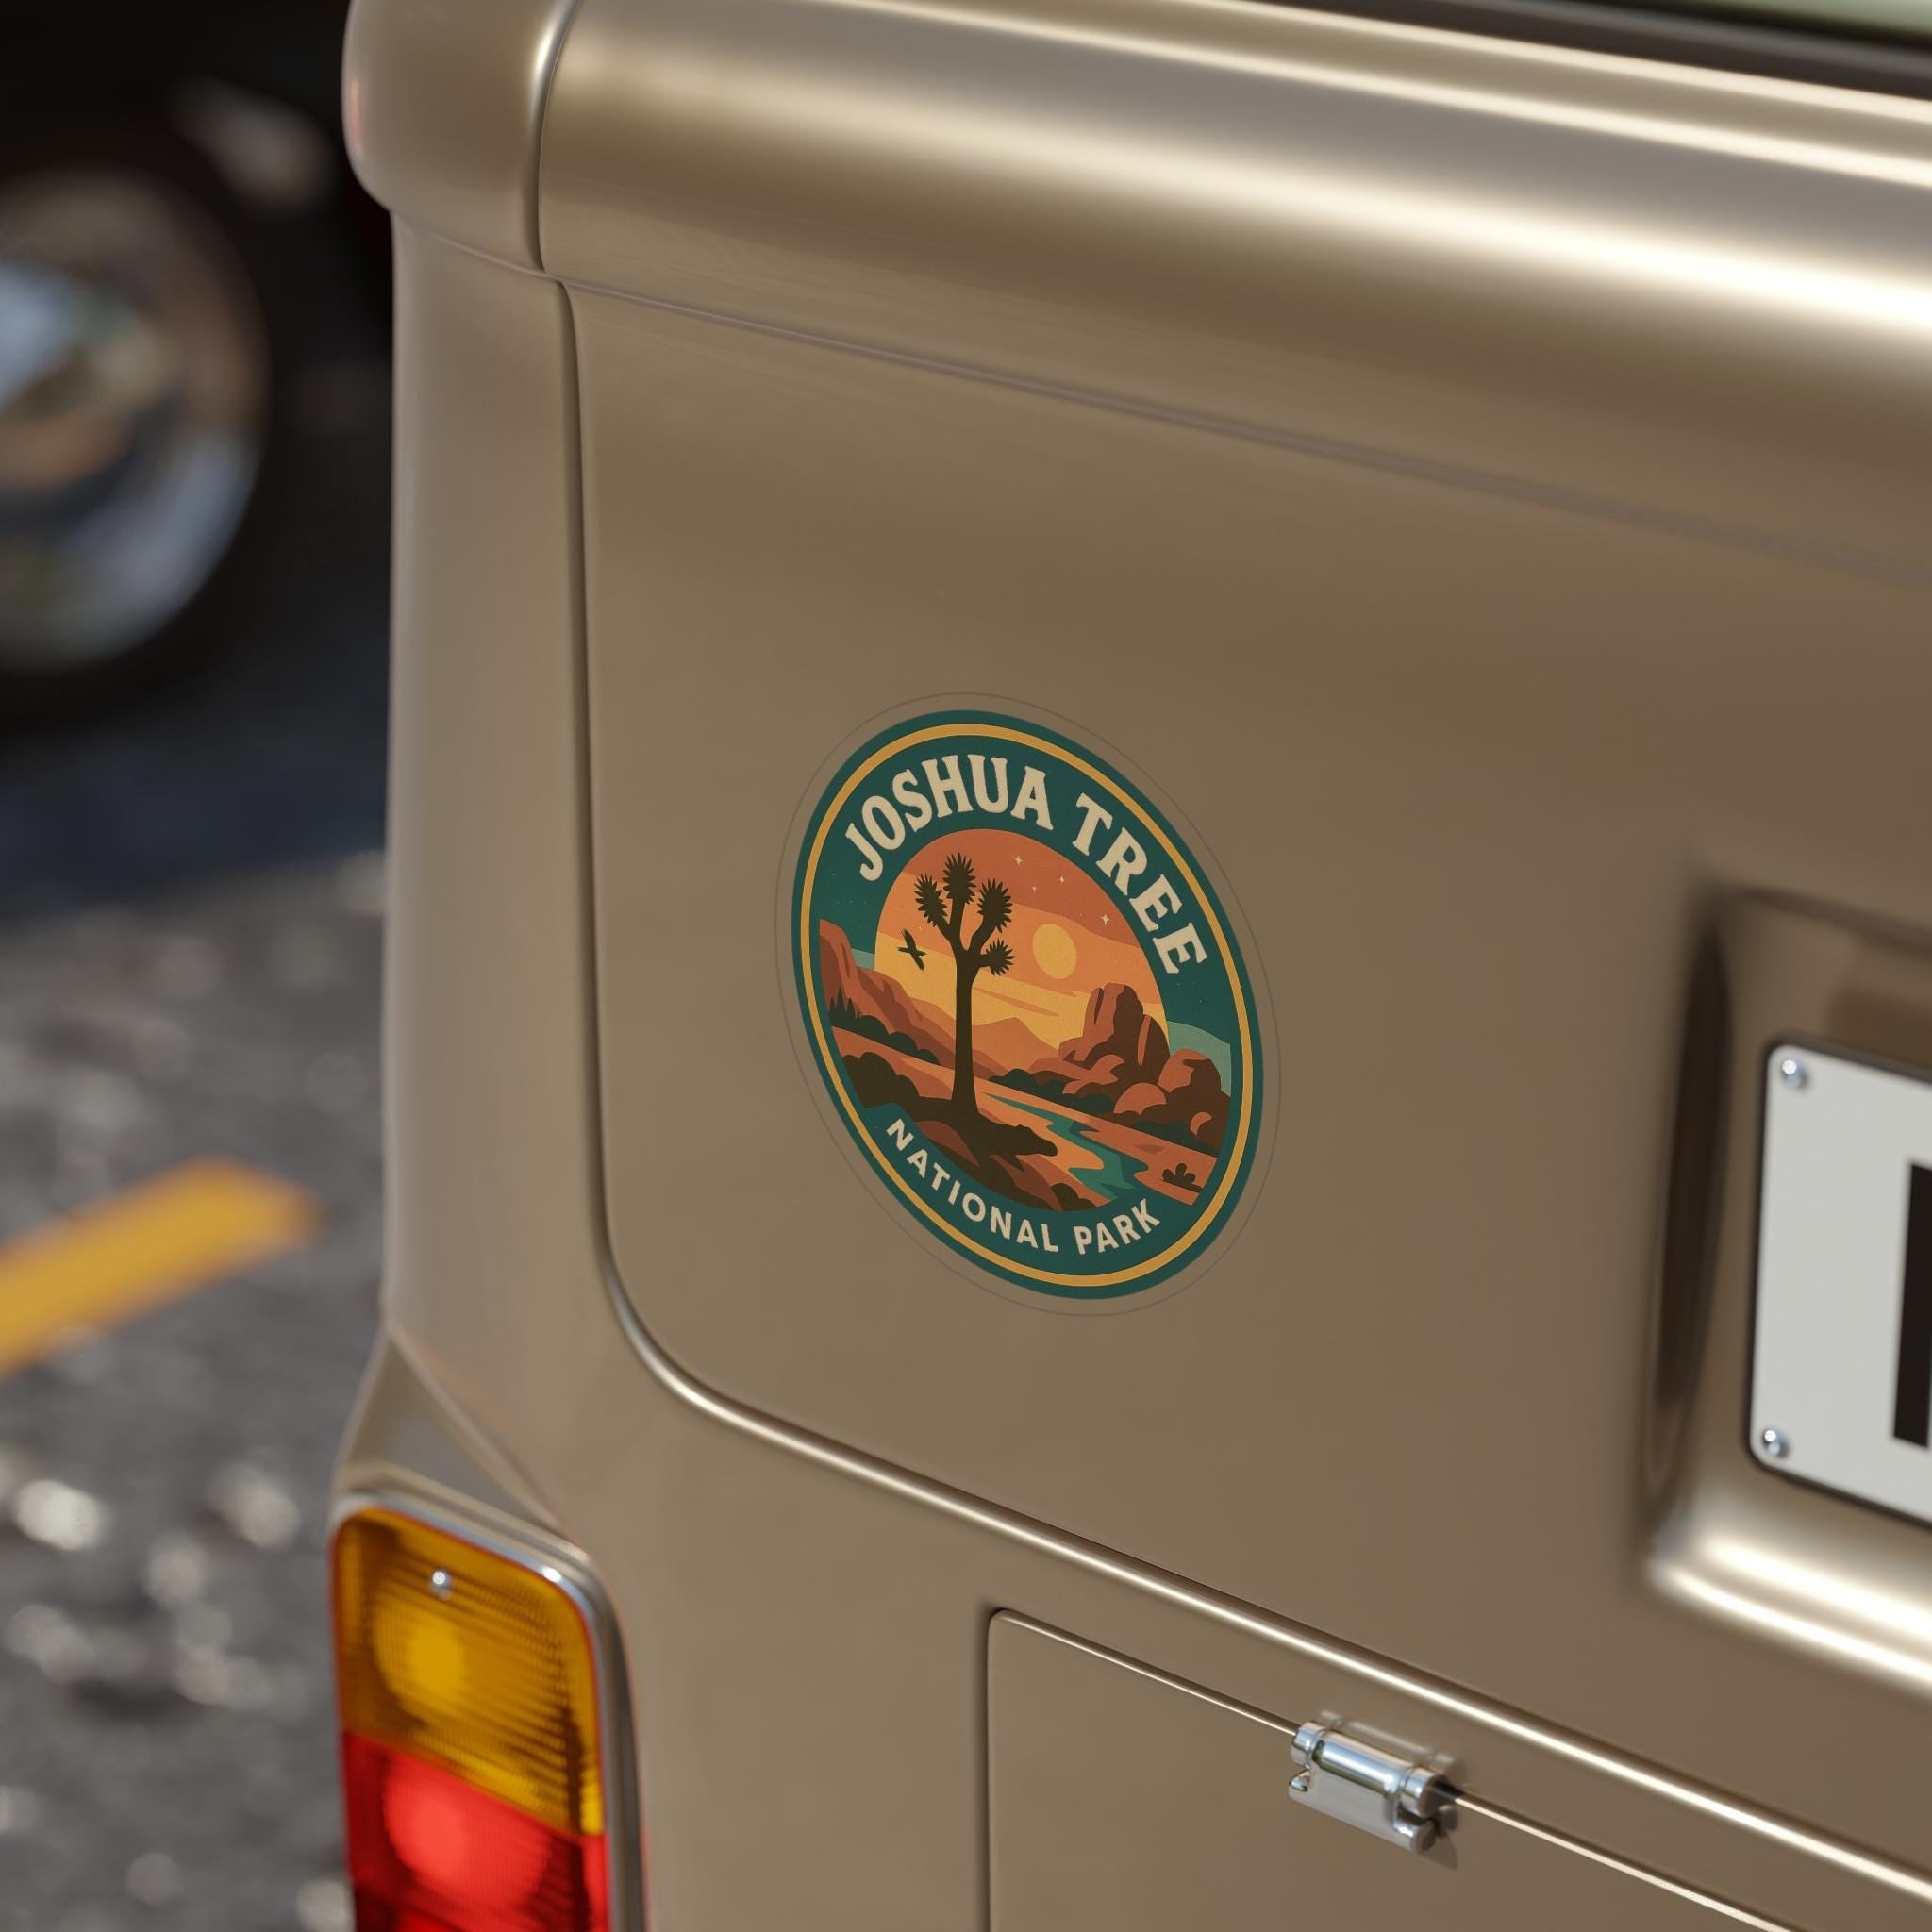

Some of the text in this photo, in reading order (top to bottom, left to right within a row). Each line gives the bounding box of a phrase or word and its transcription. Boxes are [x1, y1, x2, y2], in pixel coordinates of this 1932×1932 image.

[845, 754, 1208, 974] JOSHUA TREE
[886, 1118, 1160, 1255] NATIONAL PARK
